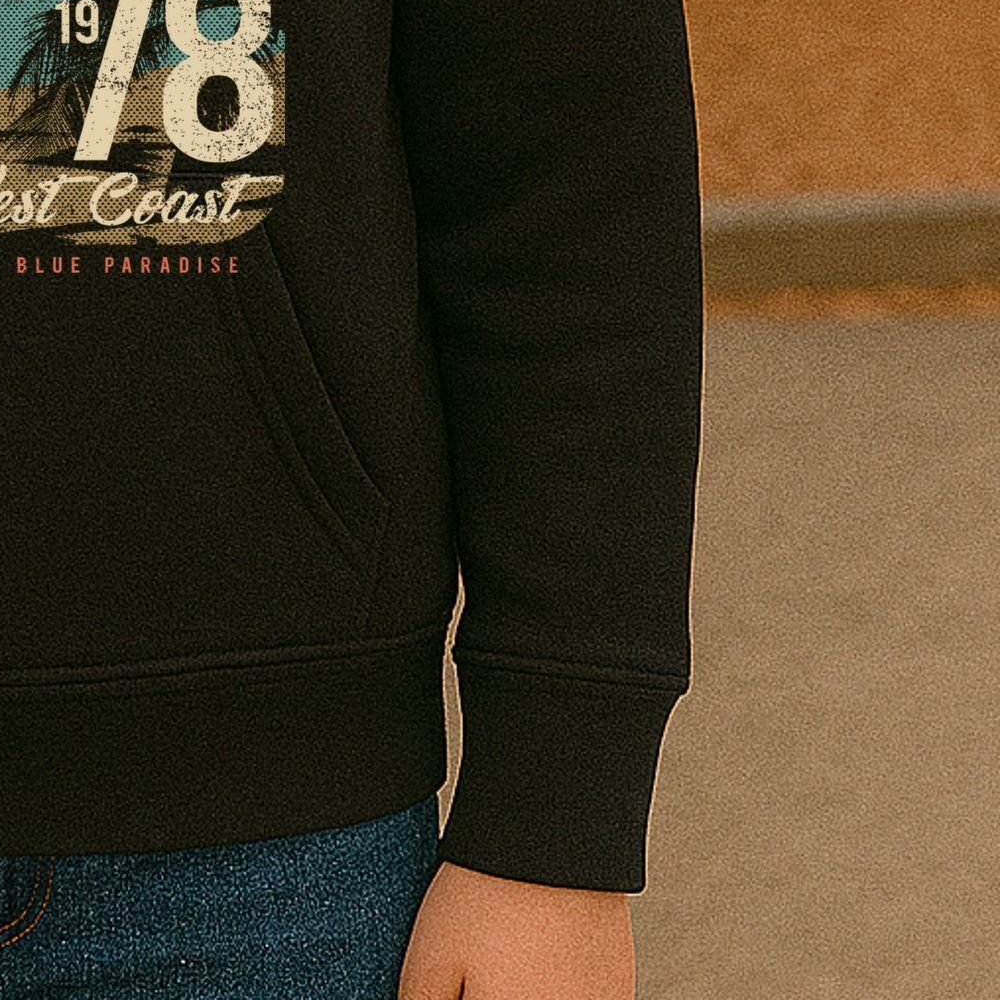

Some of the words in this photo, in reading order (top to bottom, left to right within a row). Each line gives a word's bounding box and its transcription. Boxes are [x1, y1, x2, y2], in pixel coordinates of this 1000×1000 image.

[91, 171, 284, 227] Coast
[16, 256, 82, 275] BLUE
[103, 256, 241, 275] PARADISE
